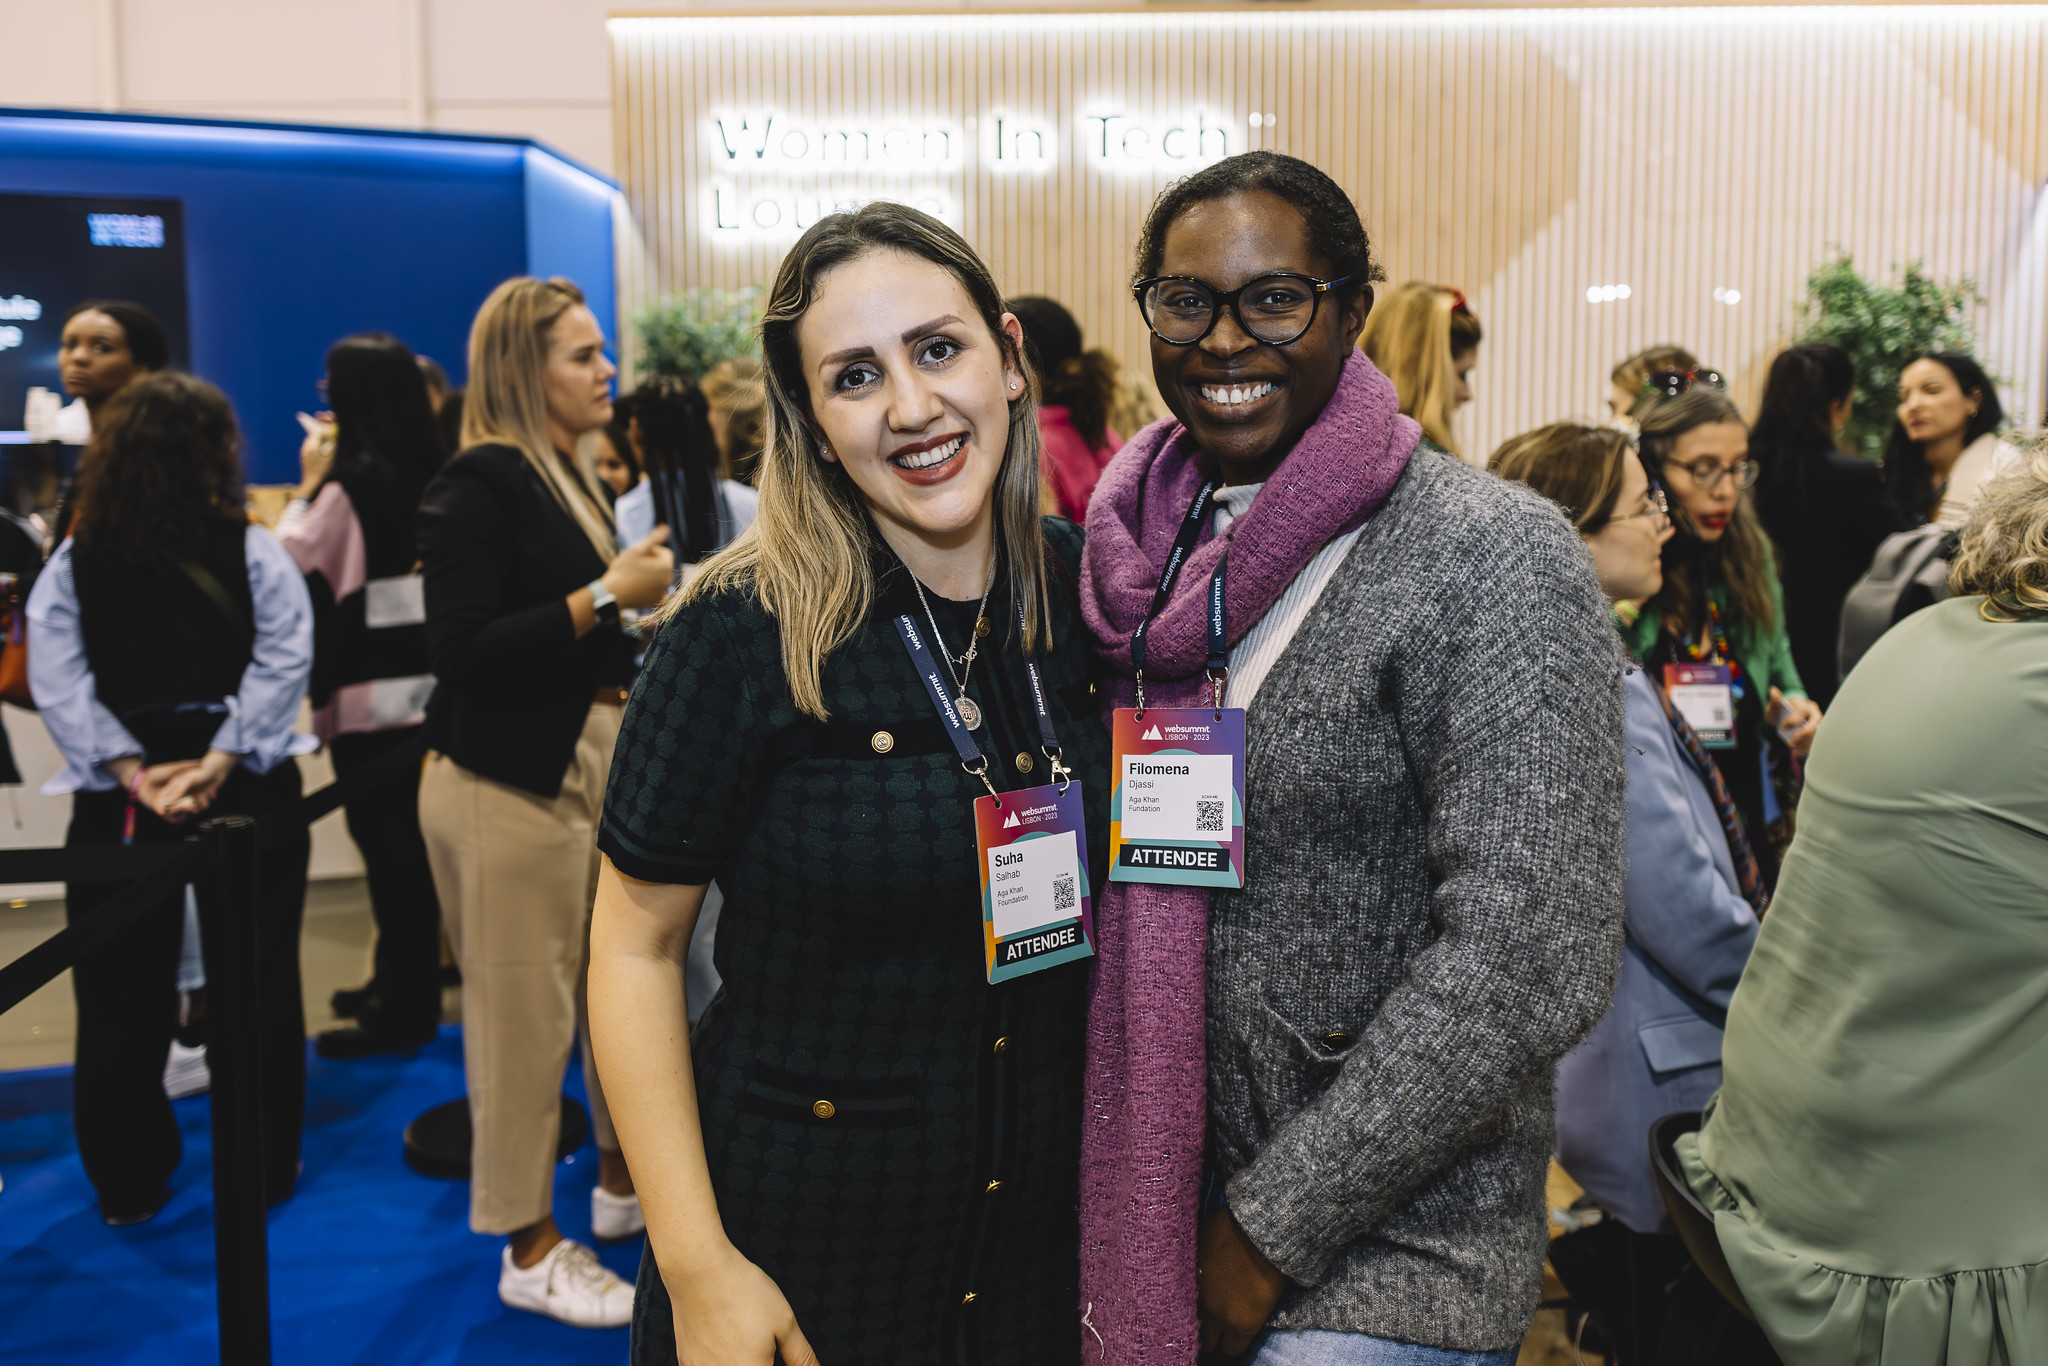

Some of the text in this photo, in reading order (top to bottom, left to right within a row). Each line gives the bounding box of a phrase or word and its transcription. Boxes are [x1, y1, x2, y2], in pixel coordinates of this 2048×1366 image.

[715, 113, 1228, 160] Women In Tech
[1161, 546, 1184, 592] websummit
[1213, 576, 1222, 637] websummit
[1028, 662, 1046, 718] websummit
[928, 672, 960, 729] websummit
[1129, 762, 1190, 775] Filomena
[1129, 779, 1154, 790] Djassi
[1128, 796, 1142, 804] Aga
[1021, 811, 1058, 825] LISBON 2023
[995, 852, 1023, 867] Suha
[1131, 848, 1218, 868] ATTENDEE
[996, 869, 1021, 882] Salhab
[997, 886, 1024, 899] Aga Khan
[997, 894, 1029, 907] Foundation
[1006, 927, 1076, 961] ATTENDEE
